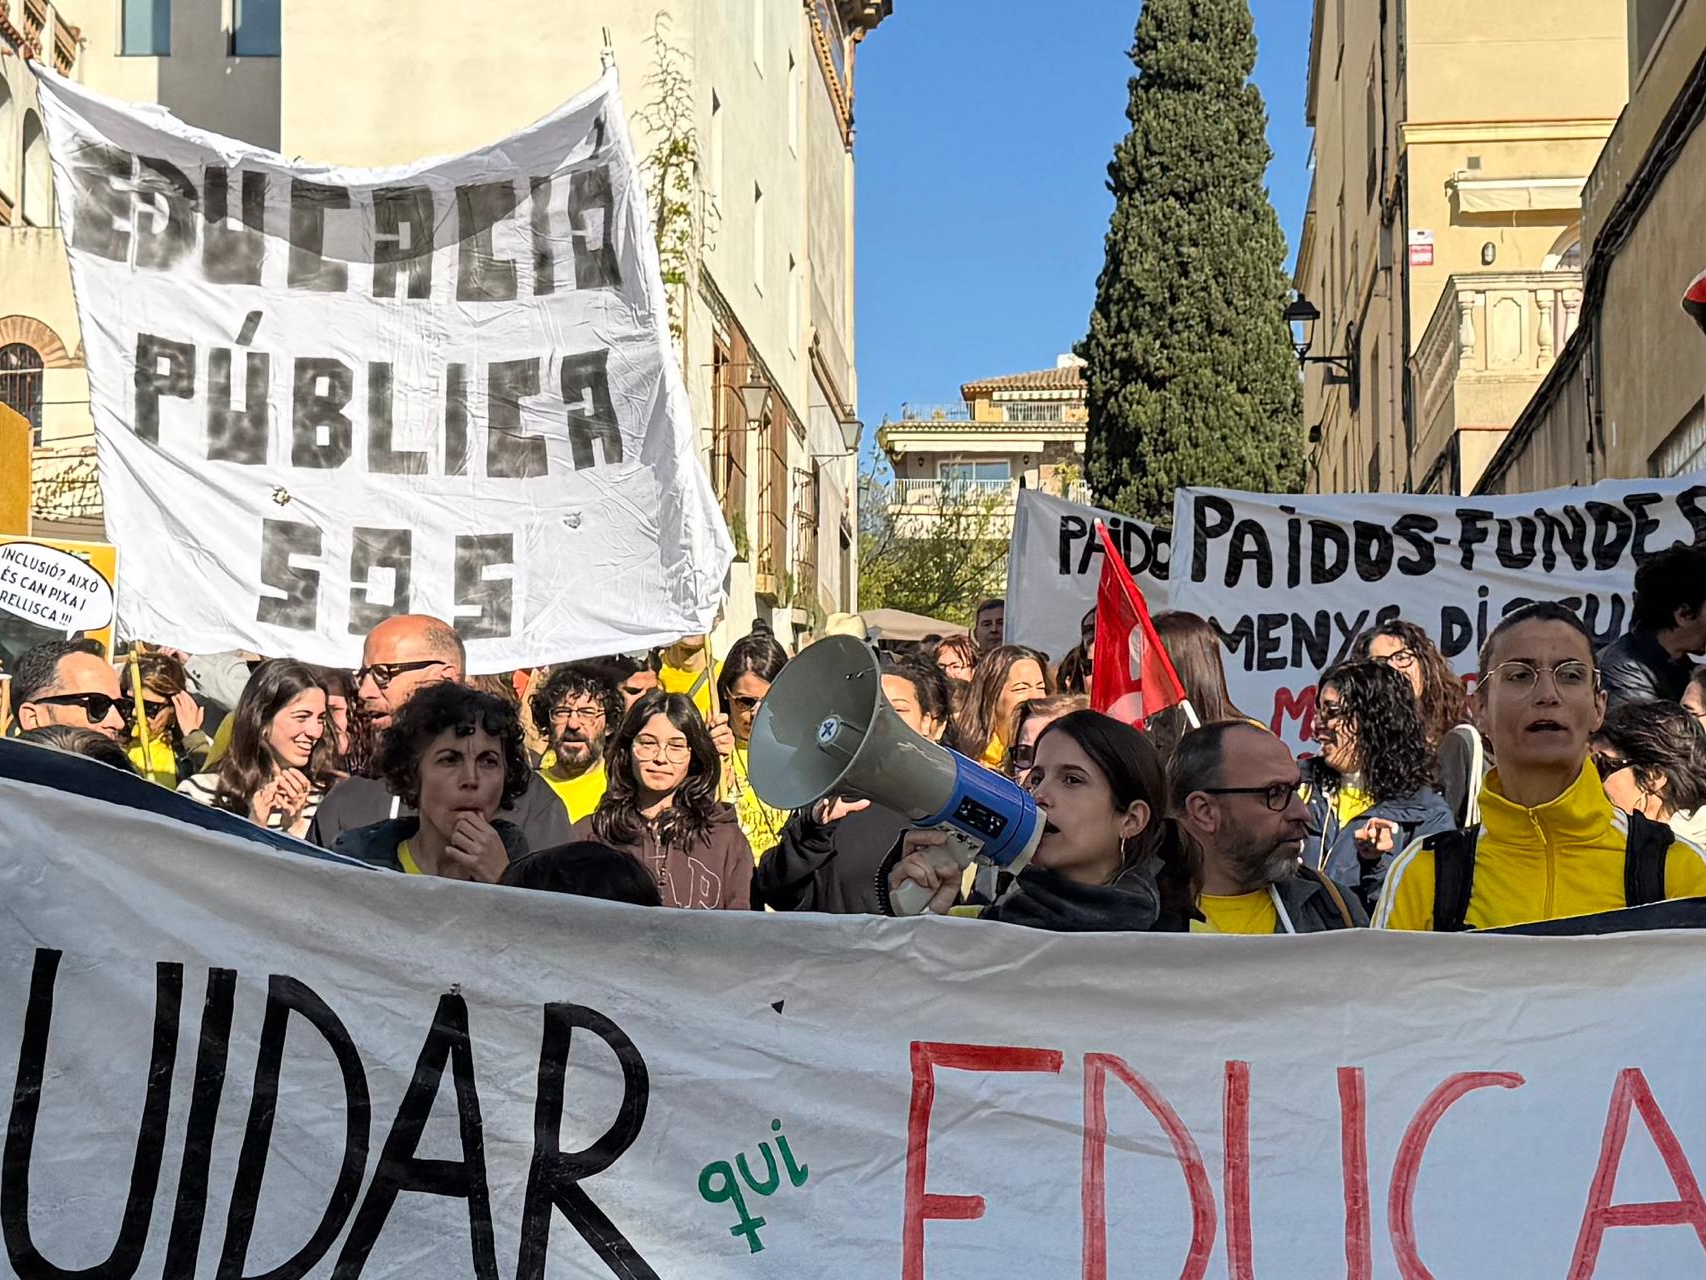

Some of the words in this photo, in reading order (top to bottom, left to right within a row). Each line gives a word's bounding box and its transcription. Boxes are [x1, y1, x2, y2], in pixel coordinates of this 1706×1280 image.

[133, 310, 624, 478] PÚBLICA
[0, 567, 18, 584] ÉS
[19, 577, 48, 595] CAN
[48, 586, 78, 608] PIXA
[0, 590, 57, 622] RELLISCA
[1, 547, 66, 581] INCLUSIÓ?
[67, 573, 99, 593] AIXÒ
[256, 517, 514, 640] SOS
[698, 1117, 810, 1255] qui
